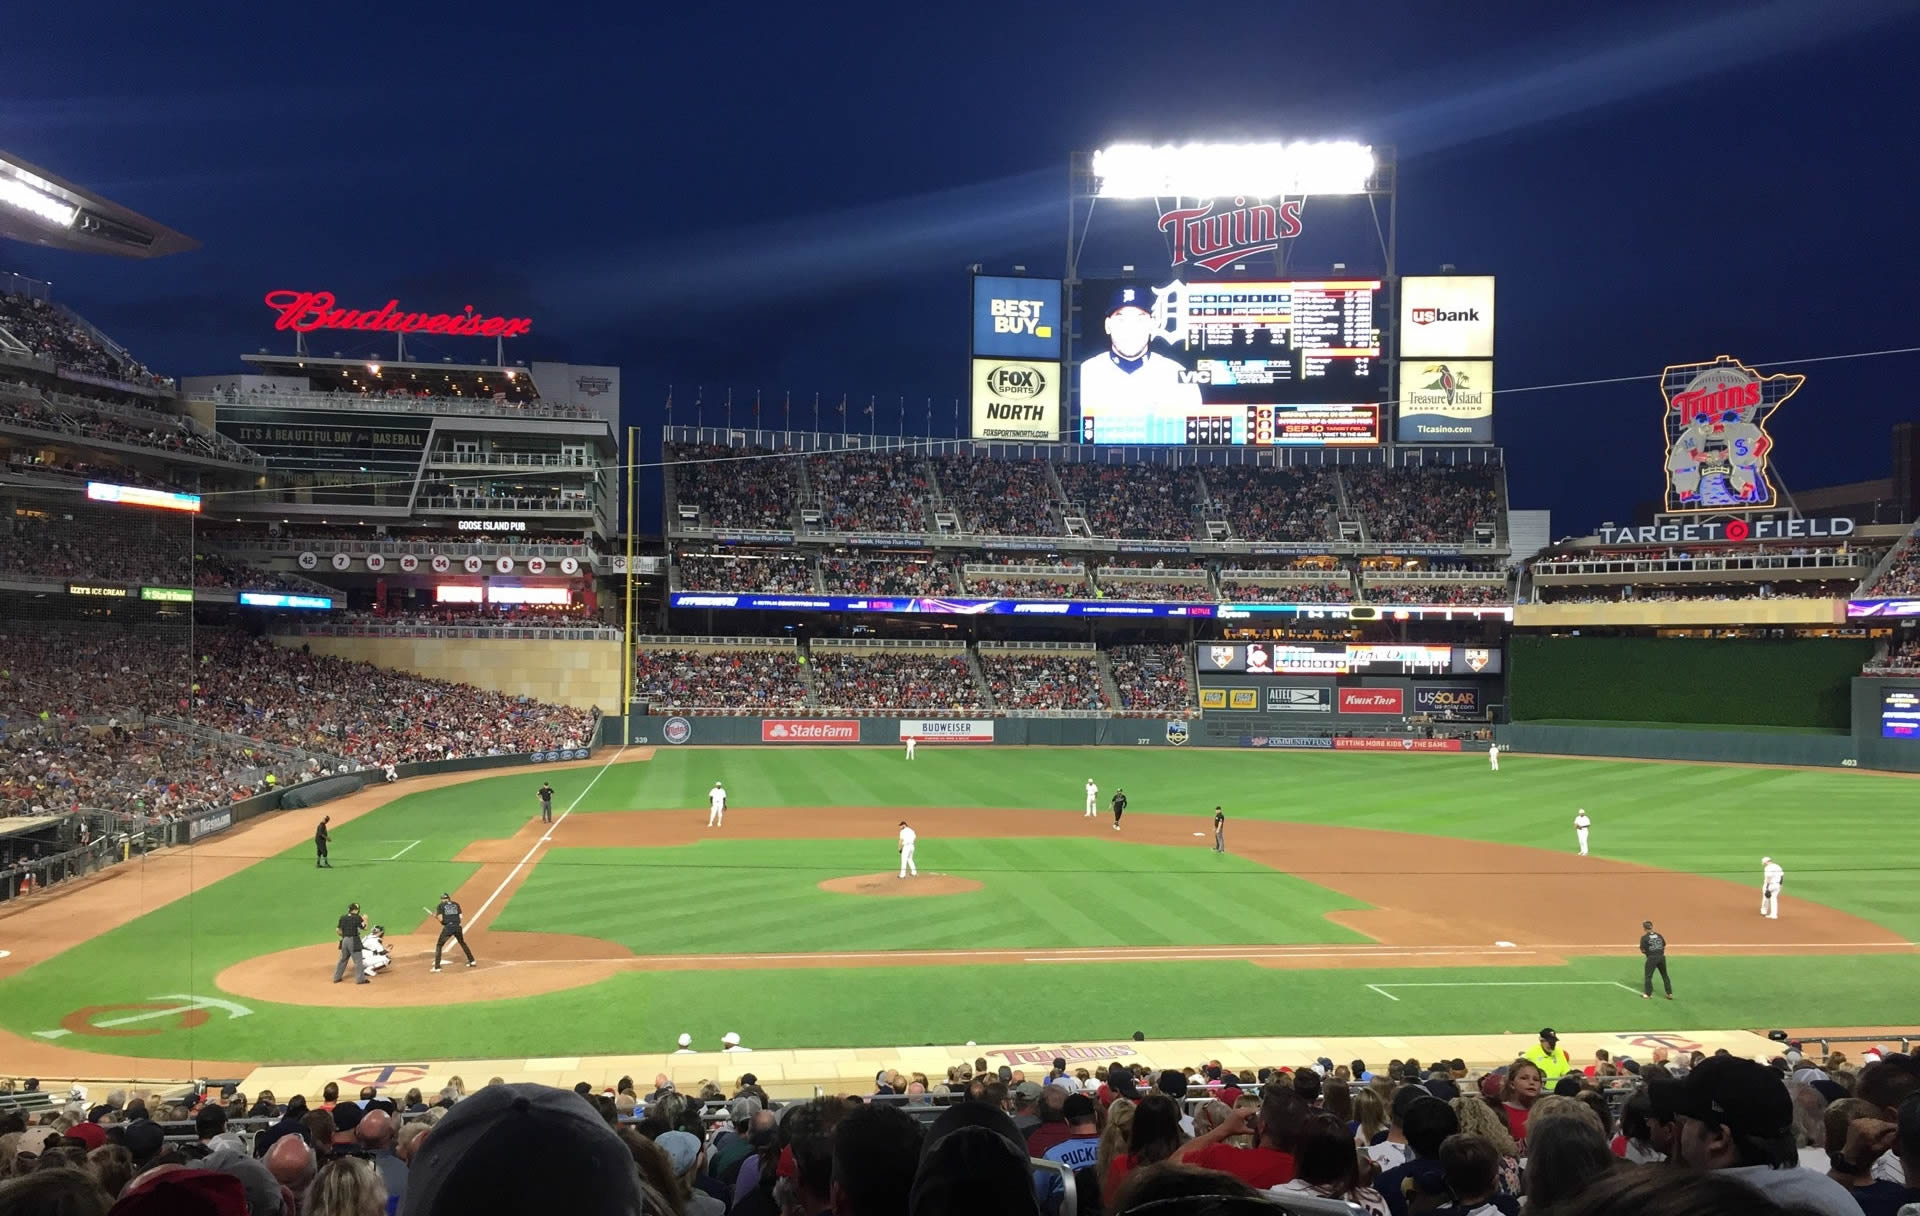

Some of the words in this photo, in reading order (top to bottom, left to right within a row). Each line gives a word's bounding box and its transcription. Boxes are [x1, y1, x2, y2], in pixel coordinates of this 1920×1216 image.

[1158, 196, 1303, 266] Twins
[265, 290, 532, 337] Budweiser
[991, 299, 1044, 318] BEST
[994, 317, 1038, 334] BUY
[1000, 371, 1032, 387] FOX
[999, 386, 1034, 394] SPORTS
[1408, 391, 1446, 404] Treasure
[1455, 391, 1482, 404] Island
[1671, 382, 1760, 426] Twins
[987, 403, 1044, 421] NORTH
[240, 428, 262, 440] IT'S
[265, 430, 272, 440] A
[275, 429, 331, 442] BEAUTIFUL
[334, 432, 352, 442] DAY
[373, 434, 422, 445] BASEBALL
[983, 428, 1049, 439] FOXSPORTSNORTH.COM
[458, 521, 482, 530] GOOSE
[483, 522, 509, 530] ISLAND
[510, 522, 526, 531] PUB
[1600, 523, 1720, 543] TARGET
[1755, 517, 1855, 537] FIELD
[303, 557, 313, 565] 42
[338, 558, 344, 566] 7
[435, 560, 446, 568] 34
[567, 562, 572, 570] 3
[91, 587, 103, 596] ICE
[103, 588, 126, 596] CREAM
[1269, 690, 1291, 699] ALTEC
[922, 723, 971, 731] BUDWEISER
[986, 1045, 1137, 1066] Twins
